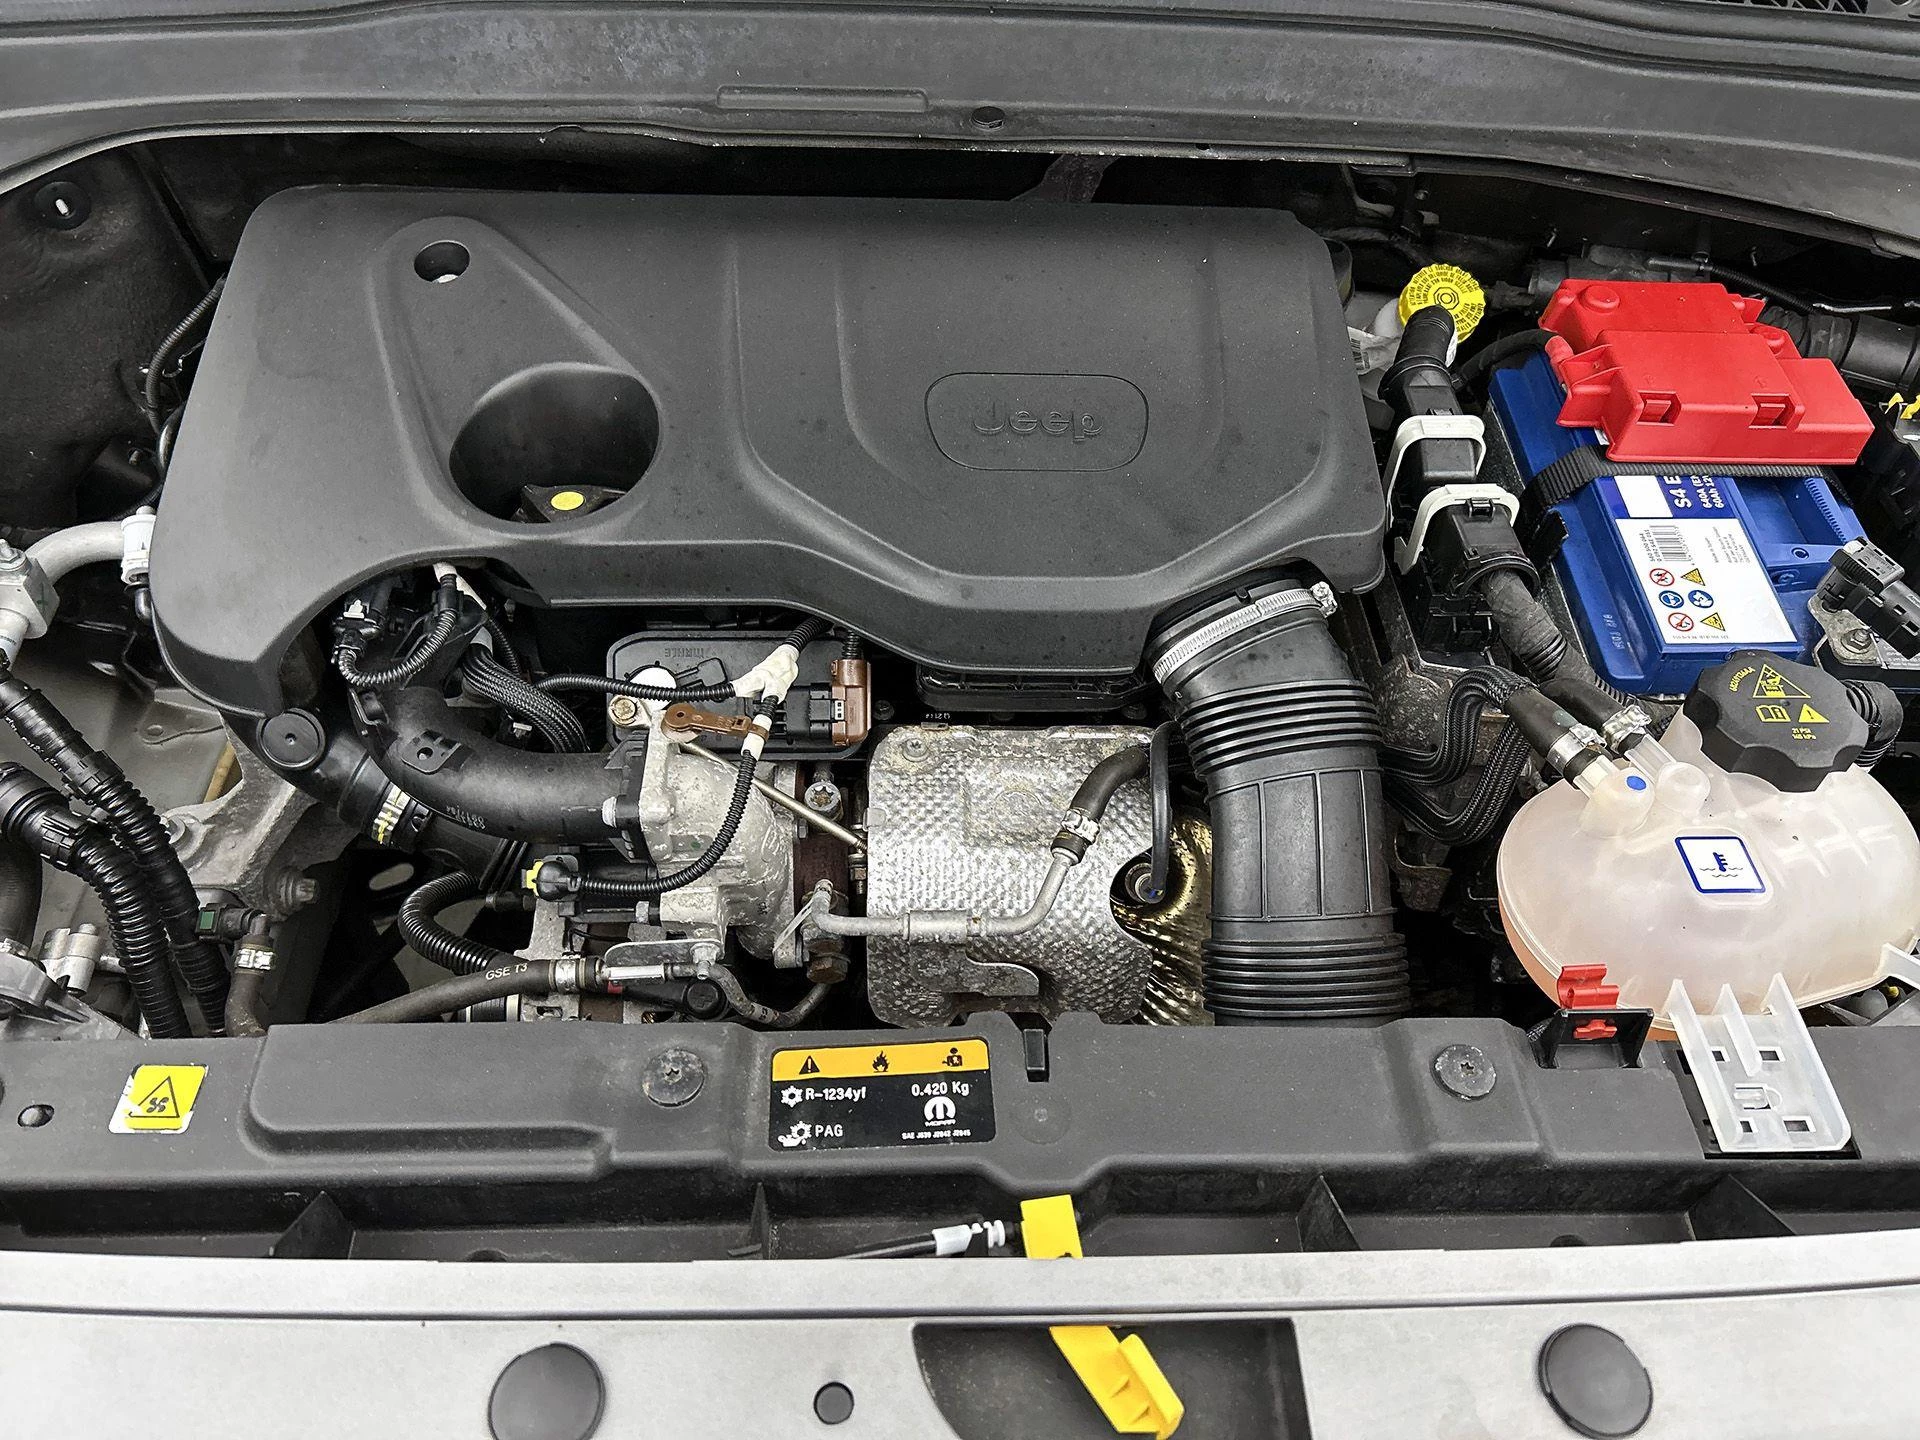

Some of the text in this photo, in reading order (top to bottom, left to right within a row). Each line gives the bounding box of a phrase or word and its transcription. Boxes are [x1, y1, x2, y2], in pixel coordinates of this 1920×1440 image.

[973, 401, 1103, 442] Jeep
[1669, 488, 1692, 508] S4
[1696, 488, 1713, 508] 640A
[1708, 488, 1725, 508] 60Ah
[485, 962, 528, 980] GSE T3
[805, 1086, 867, 1102] R-1234yf
[911, 1081, 970, 1097] 0.420 Kg
[815, 1124, 843, 1138] PAG
